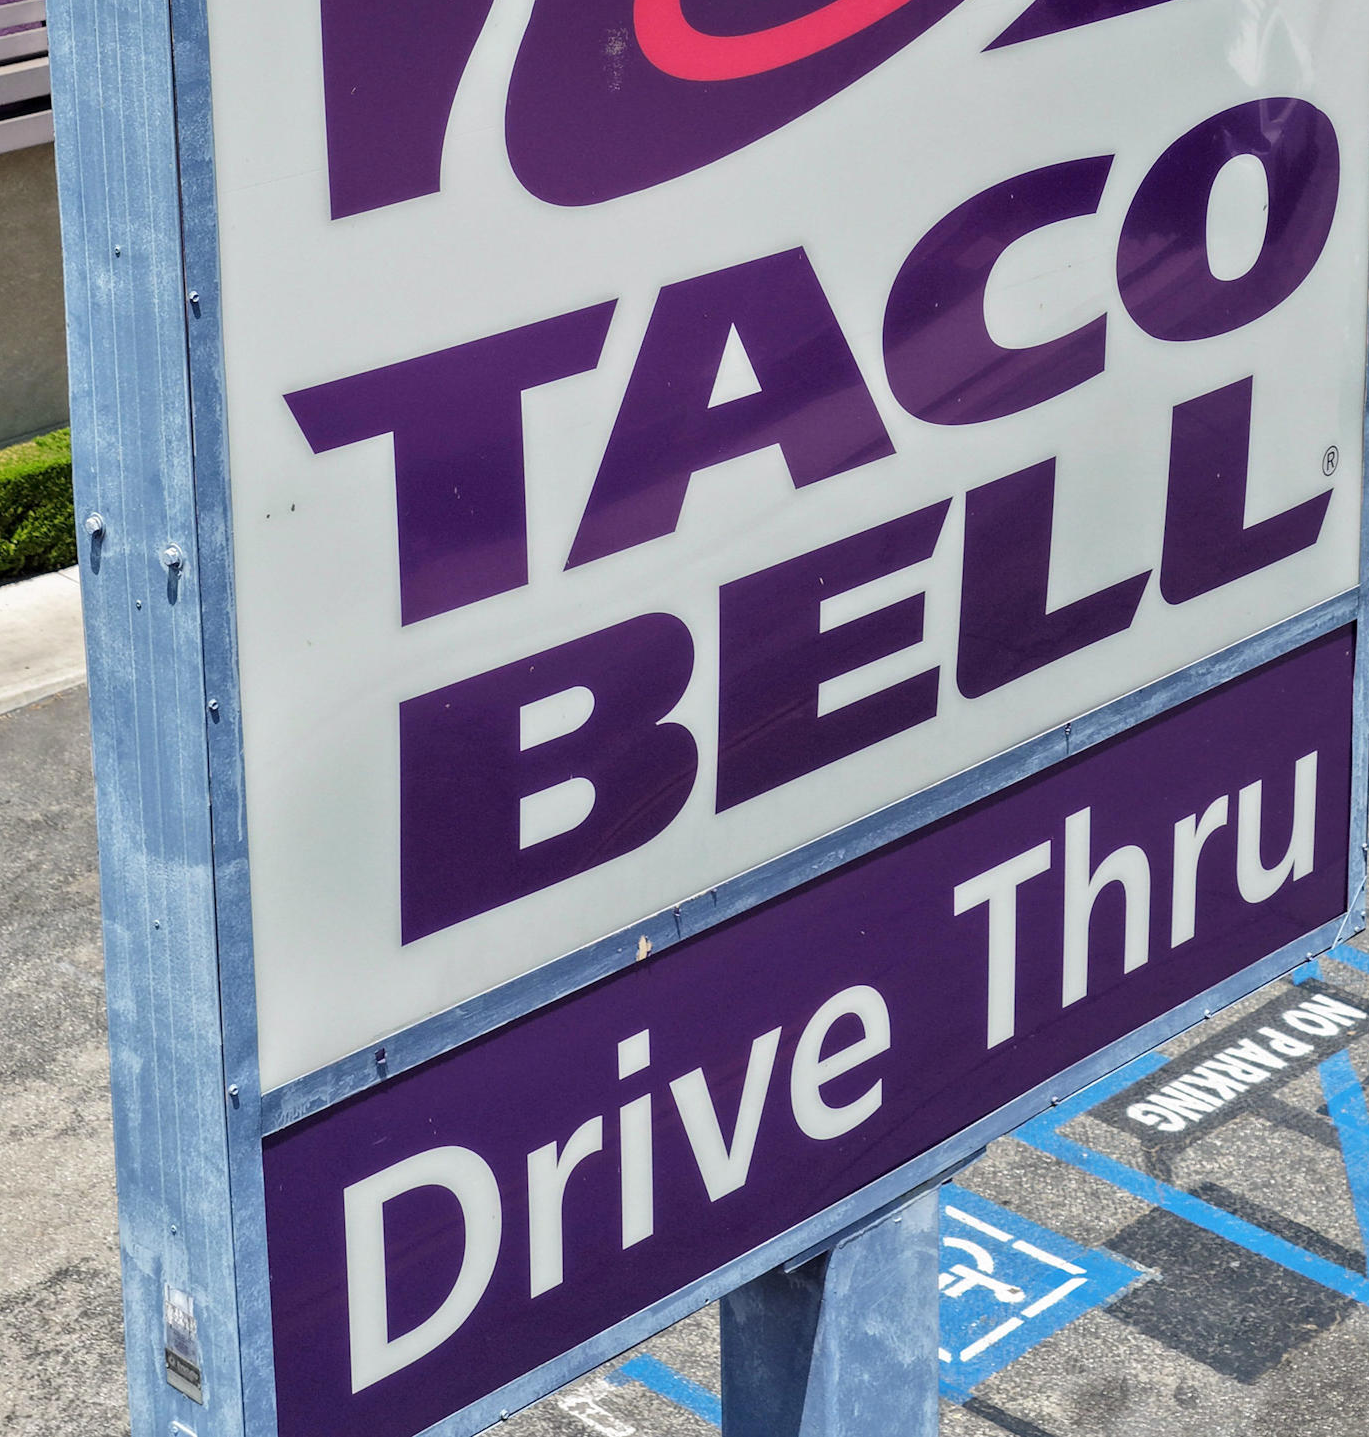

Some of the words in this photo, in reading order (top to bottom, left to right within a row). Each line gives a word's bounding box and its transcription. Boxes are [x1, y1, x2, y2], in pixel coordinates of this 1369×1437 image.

[283, 97, 1340, 627] TACO
[399, 375, 1334, 946] BELL
[344, 985, 890, 1394] Drive
[954, 751, 1317, 1049] Thru
[1127, 1027, 1314, 1131] PARKING
[1283, 994, 1366, 1036] NO
